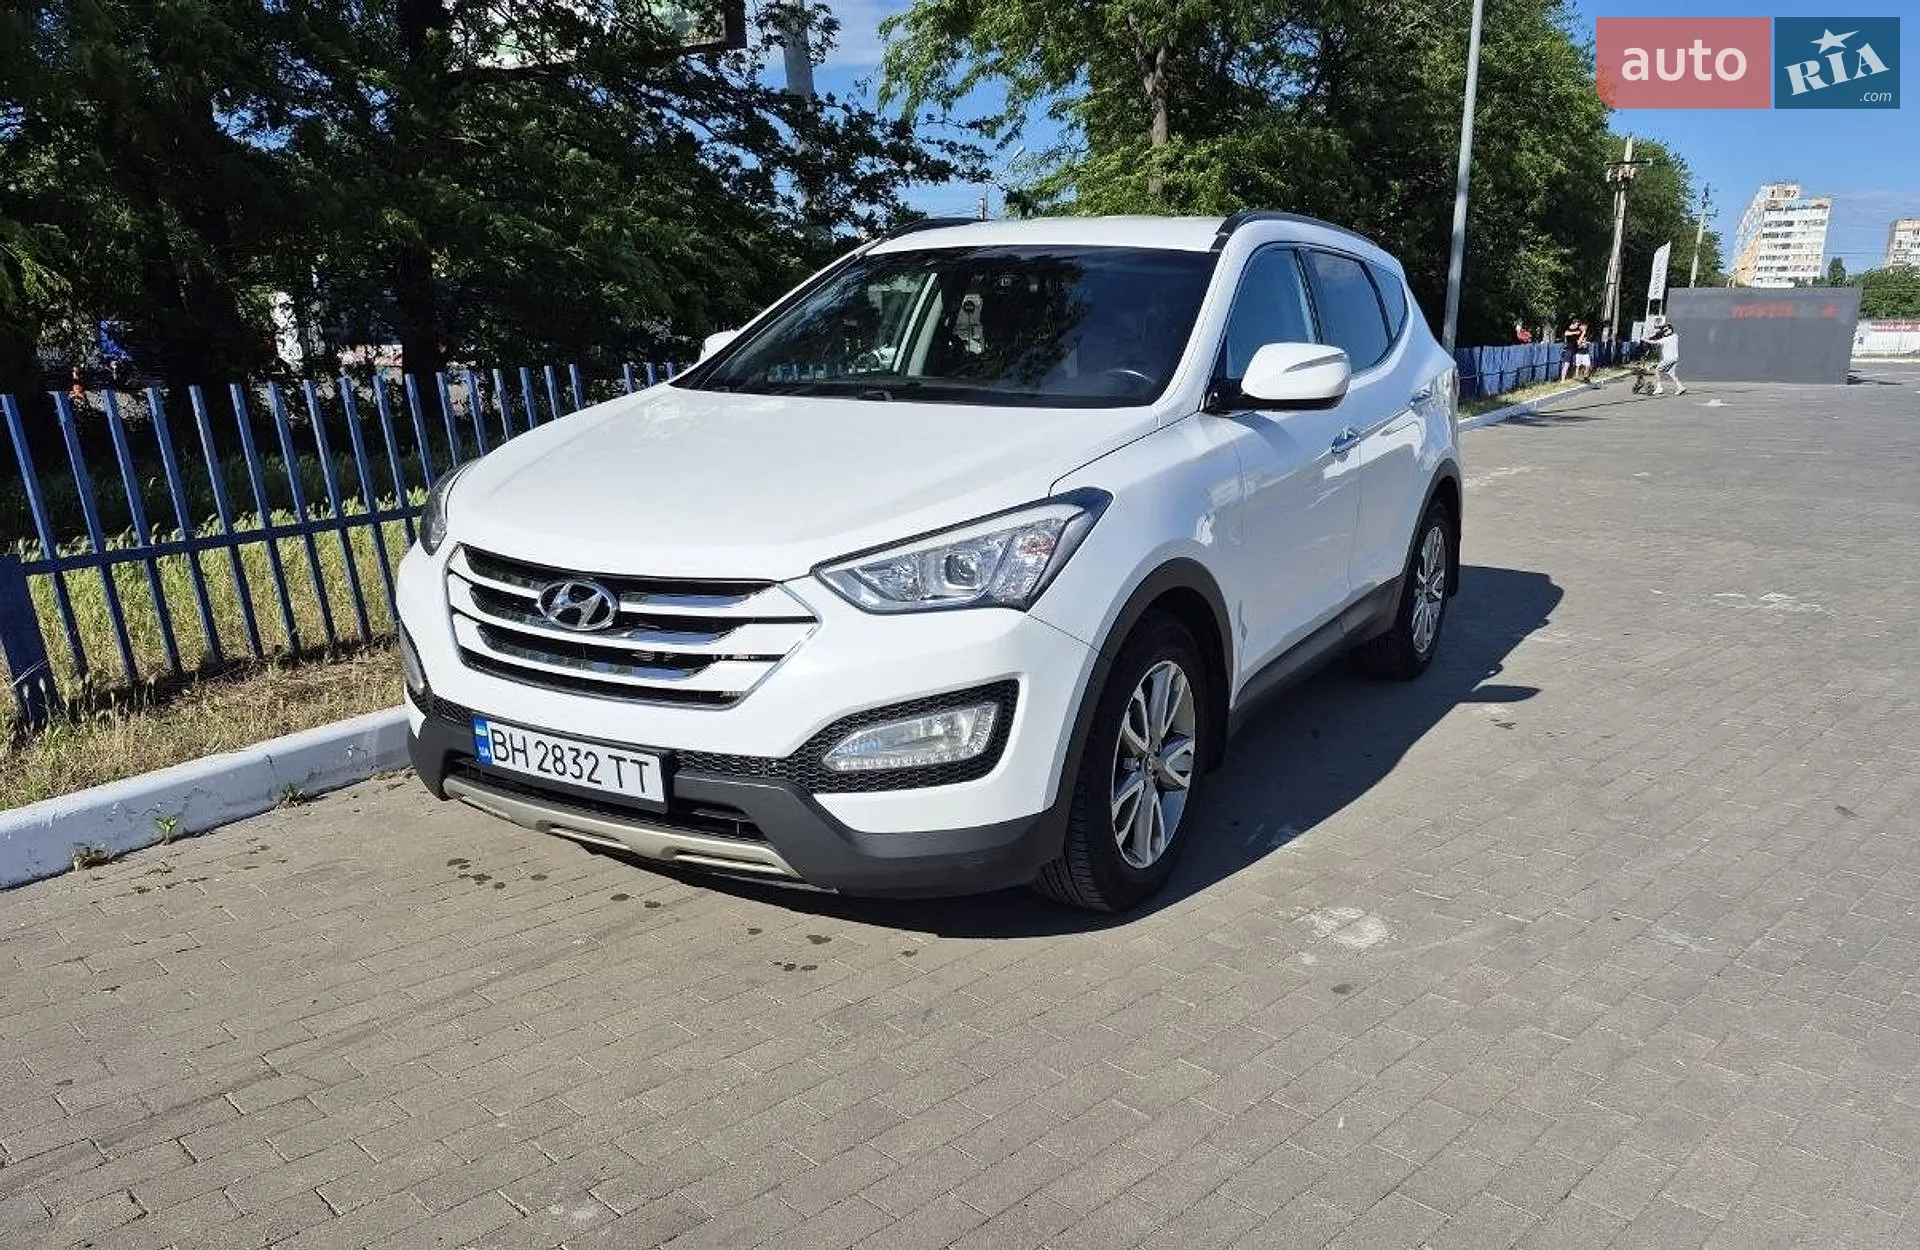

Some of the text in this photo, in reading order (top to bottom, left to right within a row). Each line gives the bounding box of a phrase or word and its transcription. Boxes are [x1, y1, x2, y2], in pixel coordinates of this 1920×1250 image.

[491, 728, 649, 793] BH 2832 TT
